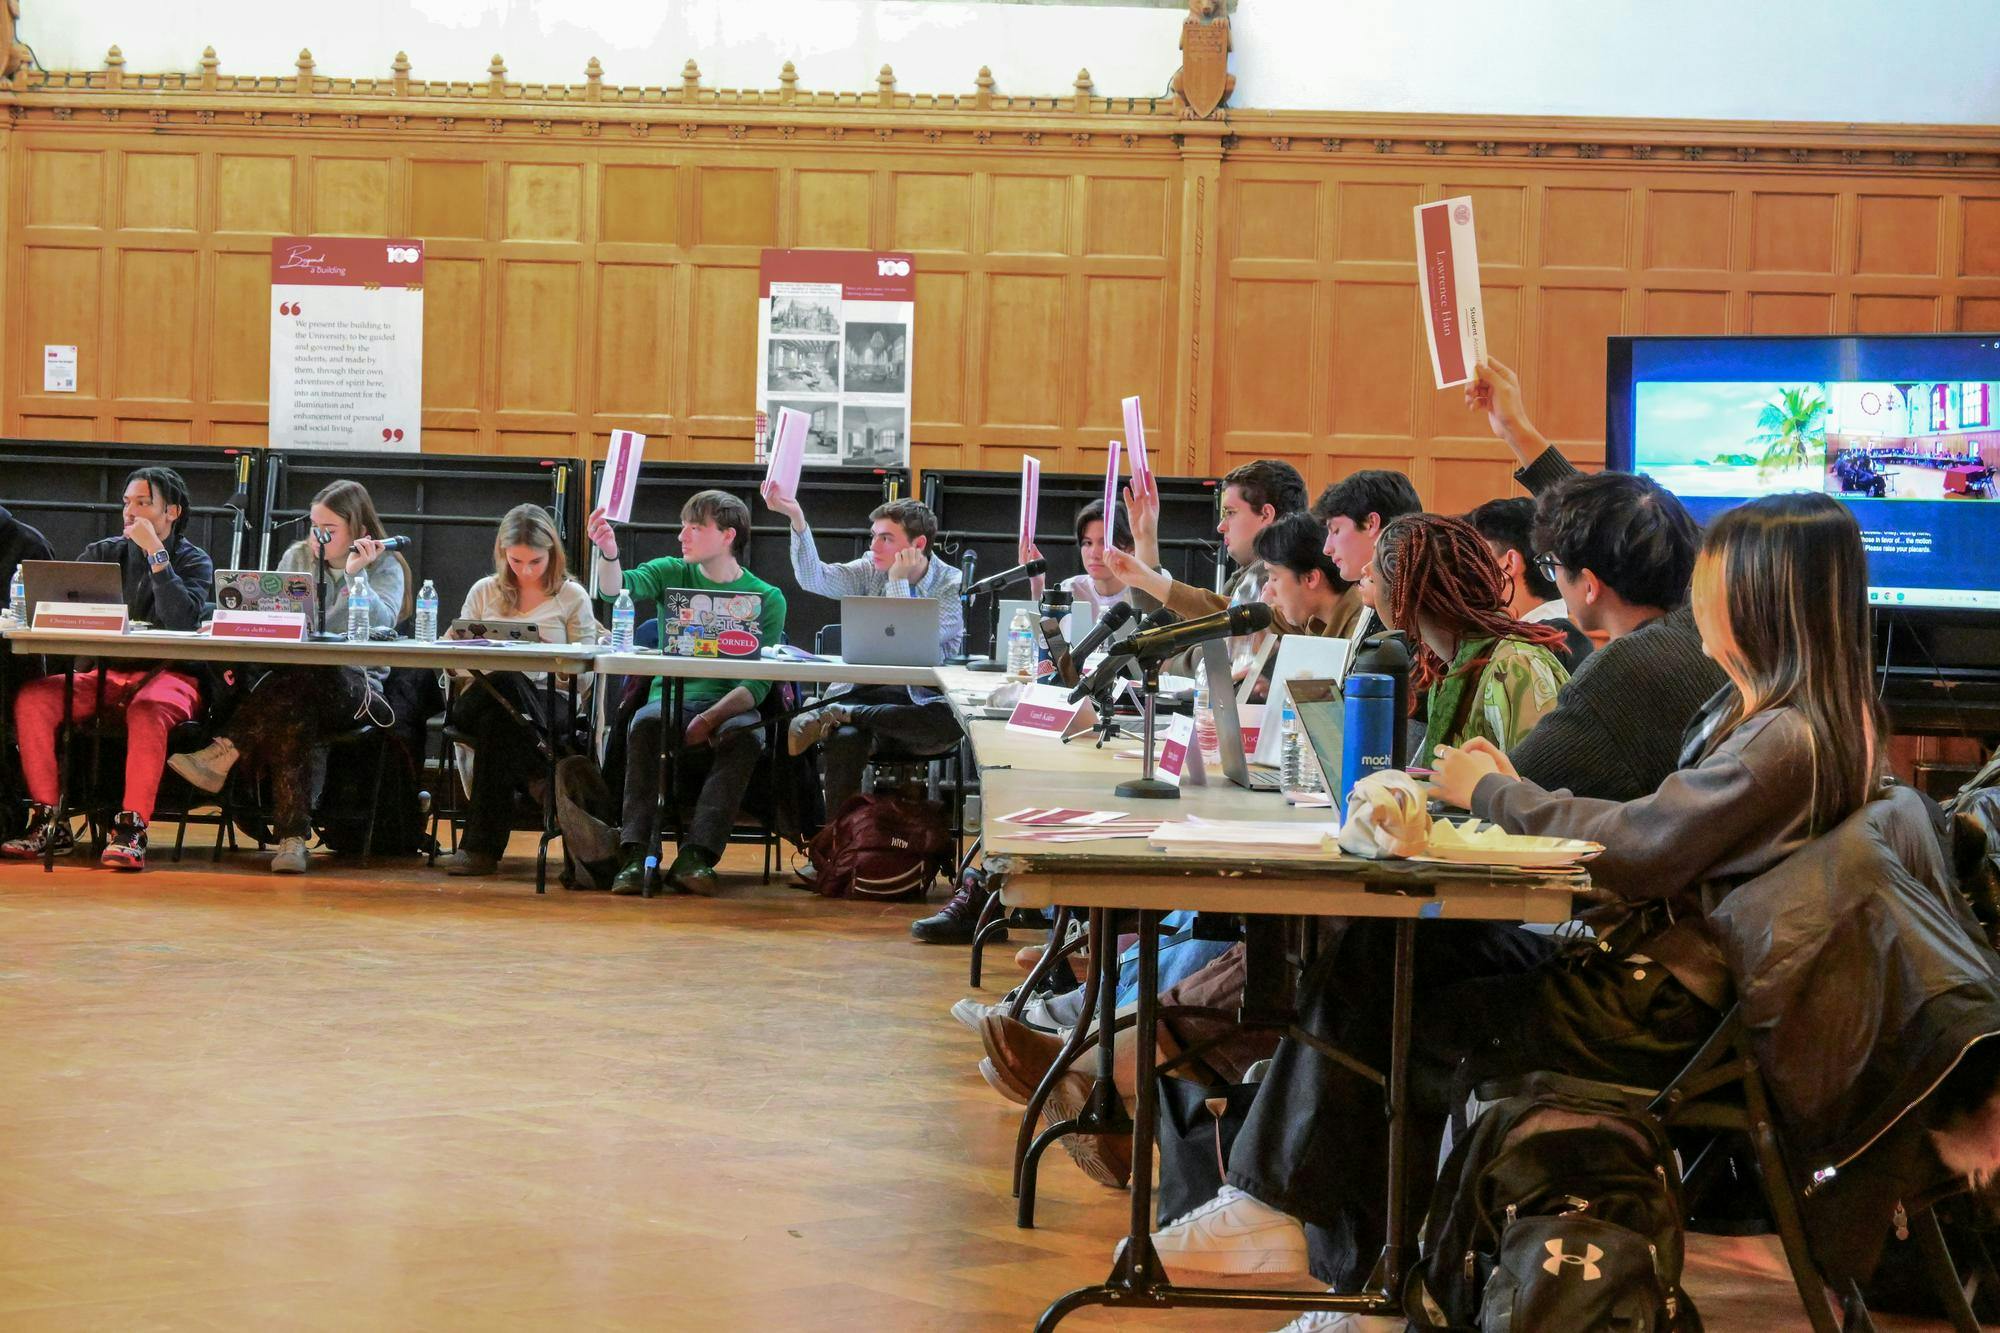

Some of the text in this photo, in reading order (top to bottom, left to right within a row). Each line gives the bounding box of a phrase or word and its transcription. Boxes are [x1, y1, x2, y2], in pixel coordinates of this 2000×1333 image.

[387, 248, 419, 263] 100
[877, 260, 910, 276] 100
[1436, 250, 1452, 337] Lawrence Han
[1469, 306, 1478, 336] Student
[367, 357, 376, 365] by
[346, 379, 364, 388] spirit
